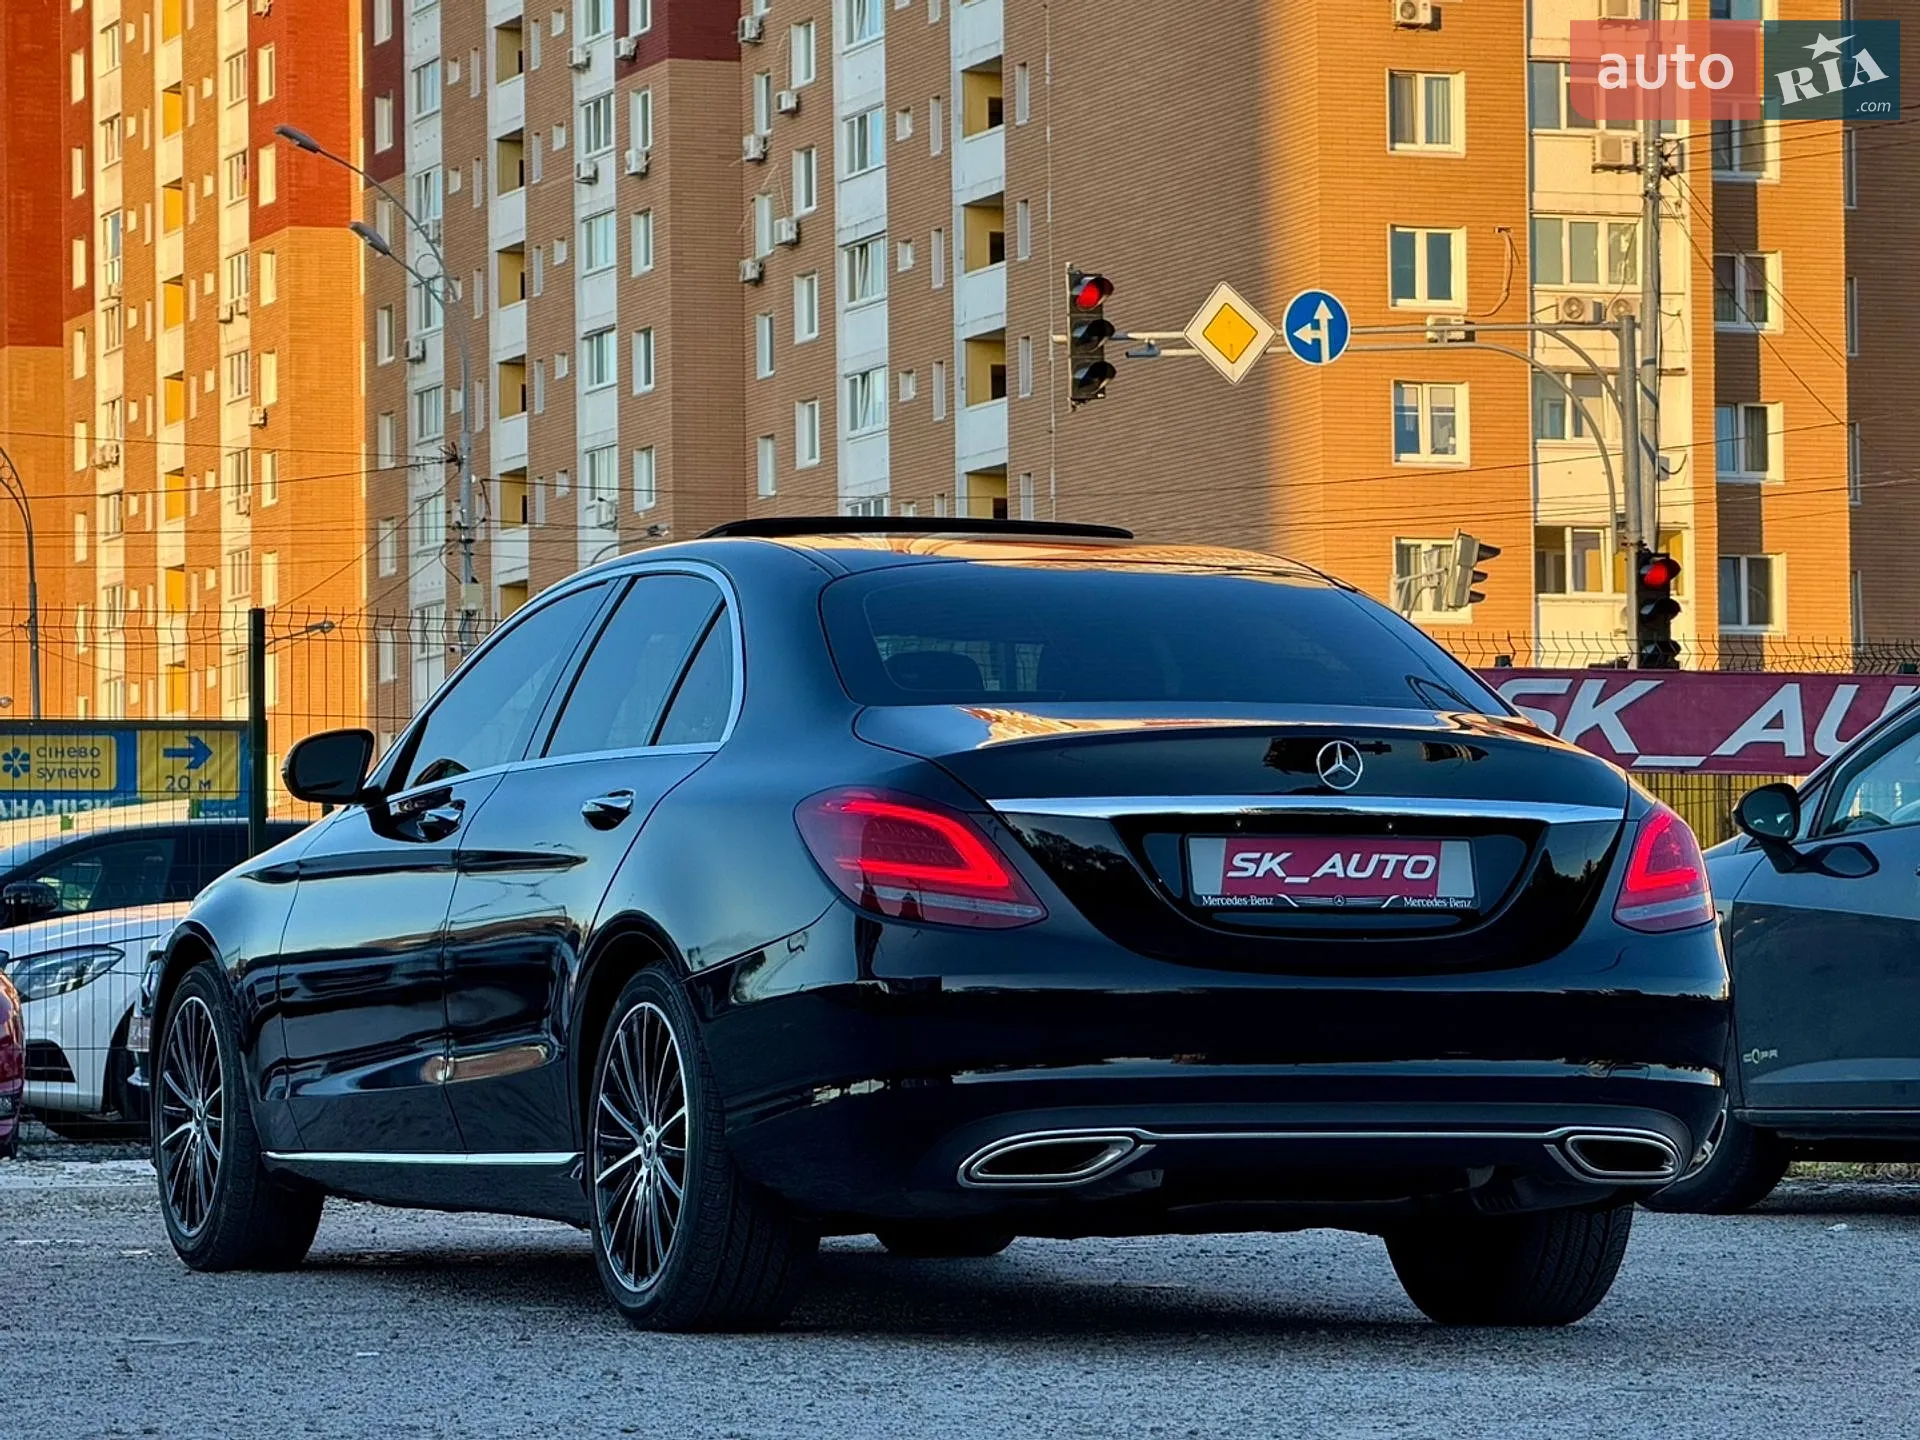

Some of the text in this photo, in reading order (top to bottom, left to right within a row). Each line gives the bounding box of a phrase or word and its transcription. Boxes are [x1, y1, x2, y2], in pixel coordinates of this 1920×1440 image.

[36, 767, 101, 782] synevo
[165, 775, 190, 792] 20
[1226, 852, 1437, 883] SK_AUTO
[1202, 894, 1274, 906] Mercedes-Benz
[1403, 896, 1472, 908] Mercedes-Benz
